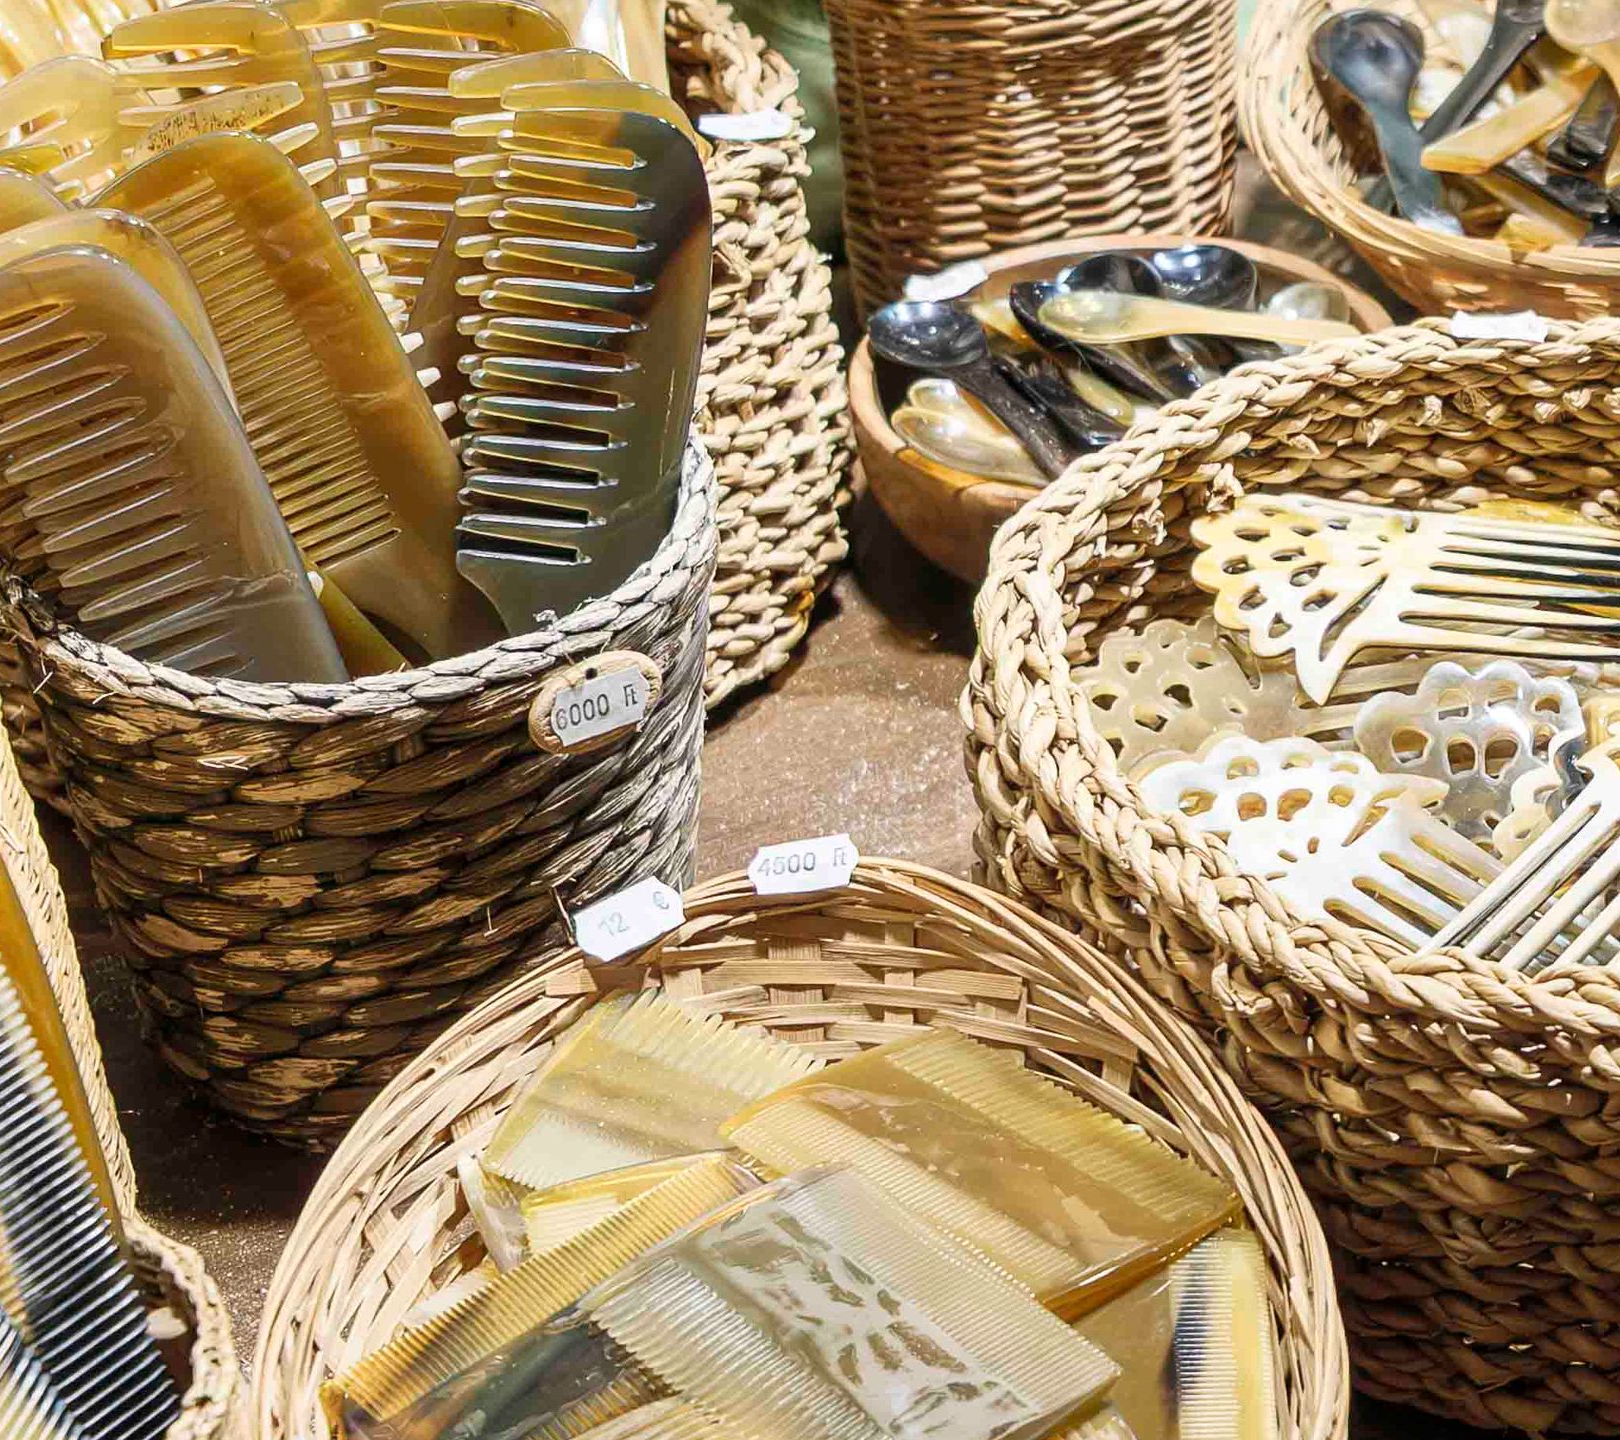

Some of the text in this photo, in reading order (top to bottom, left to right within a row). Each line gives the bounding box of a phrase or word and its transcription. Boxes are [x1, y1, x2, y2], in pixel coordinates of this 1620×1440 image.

[555, 683, 639, 732] 6000 Ft
[756, 846, 848, 878] 4500 Ft
[596, 889, 670, 941] 12 €
